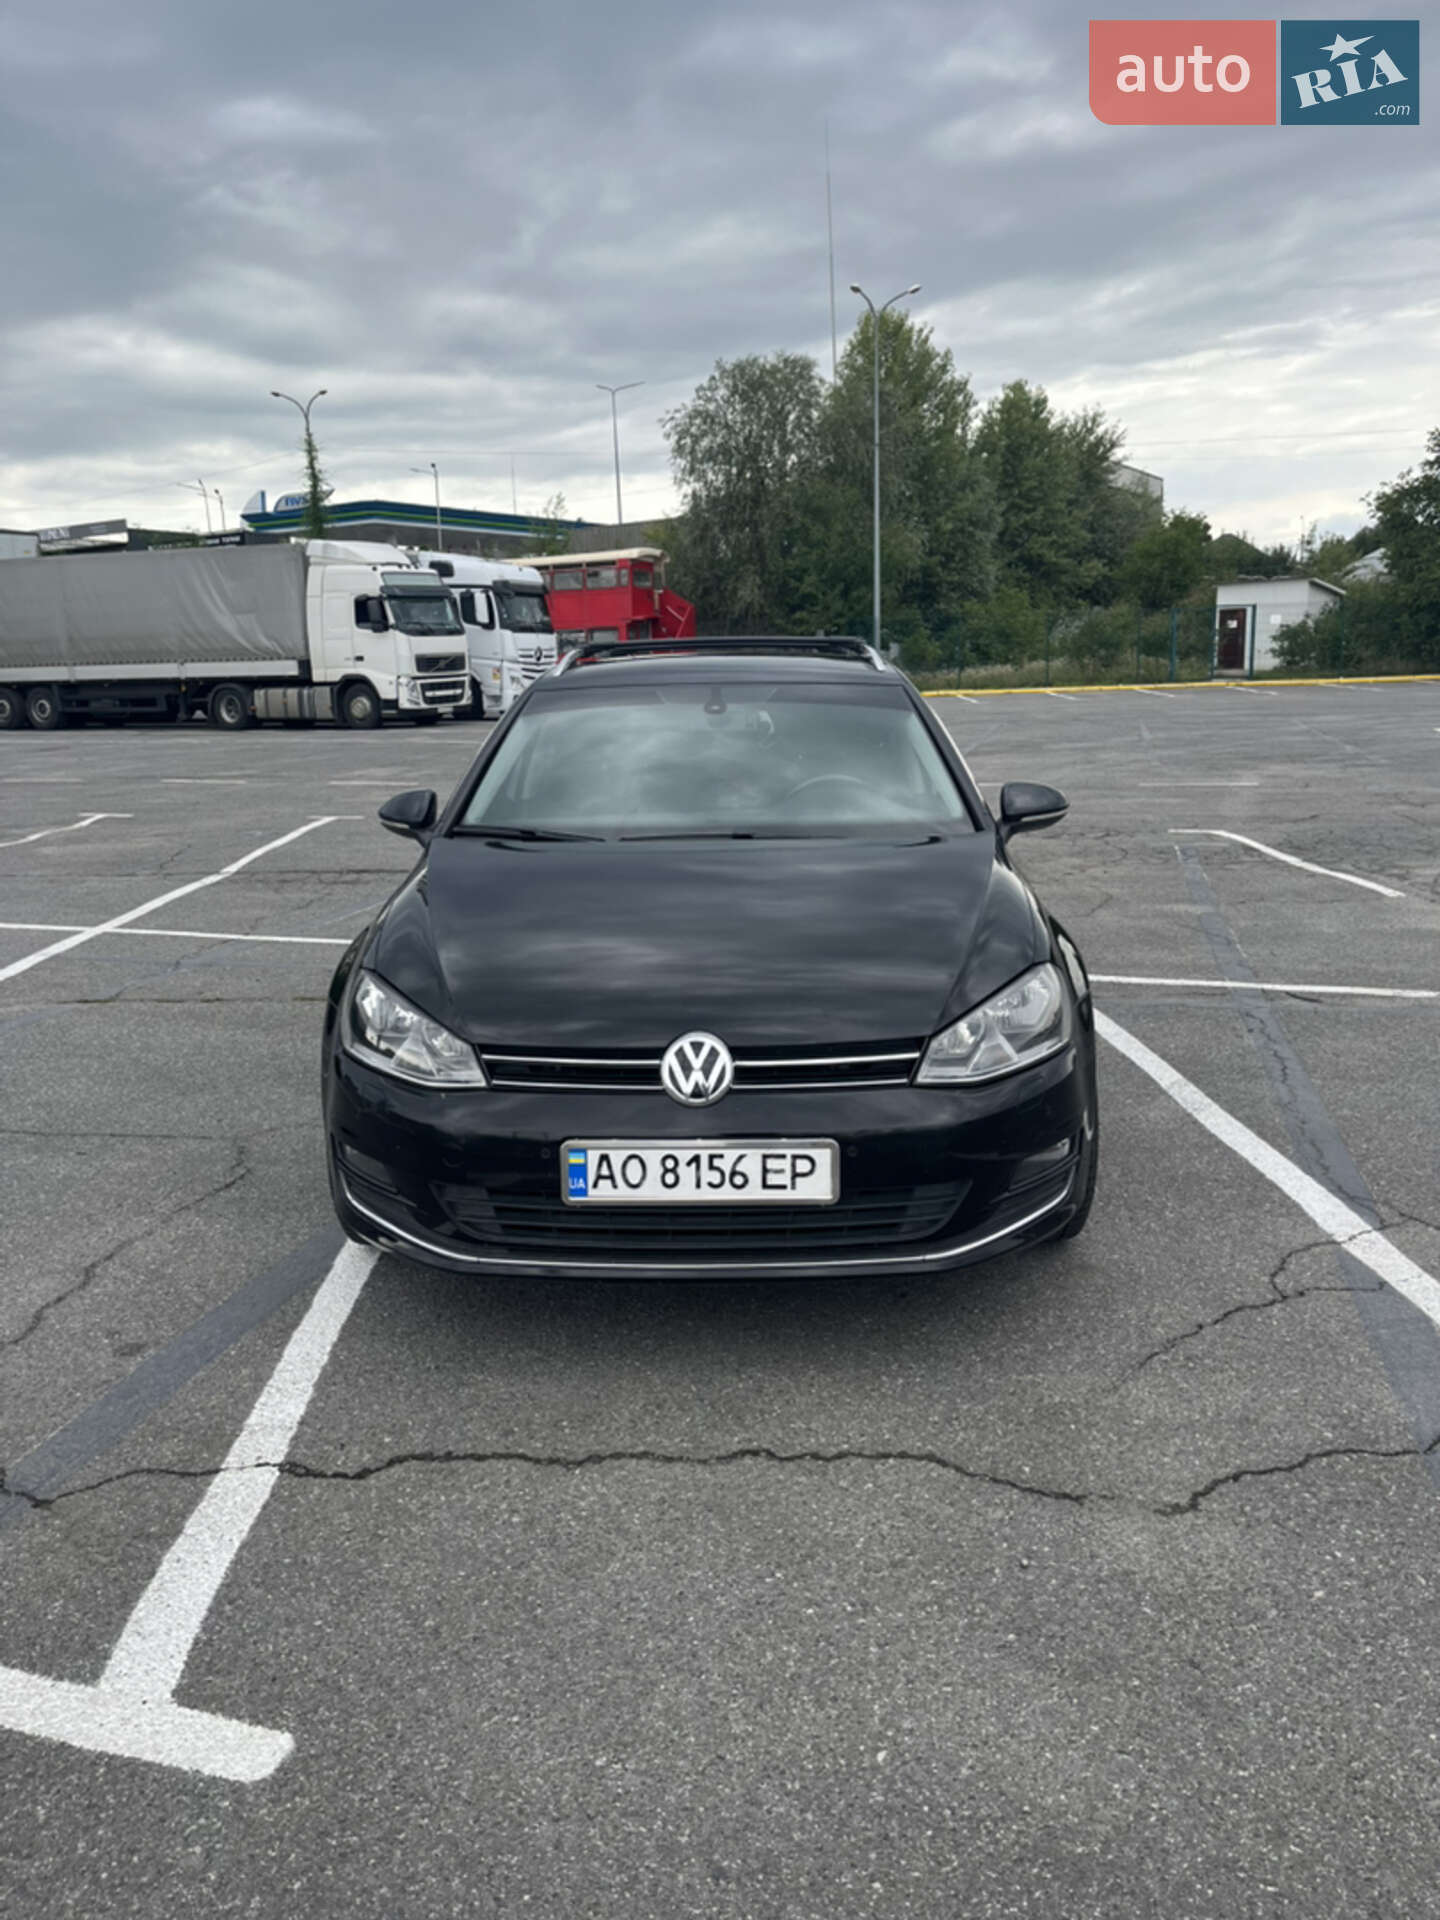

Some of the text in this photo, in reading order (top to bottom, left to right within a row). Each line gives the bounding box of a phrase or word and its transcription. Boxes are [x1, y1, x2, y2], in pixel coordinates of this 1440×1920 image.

[568, 1176, 587, 1190] UA
[591, 1153, 817, 1190] AO 8156 EP
